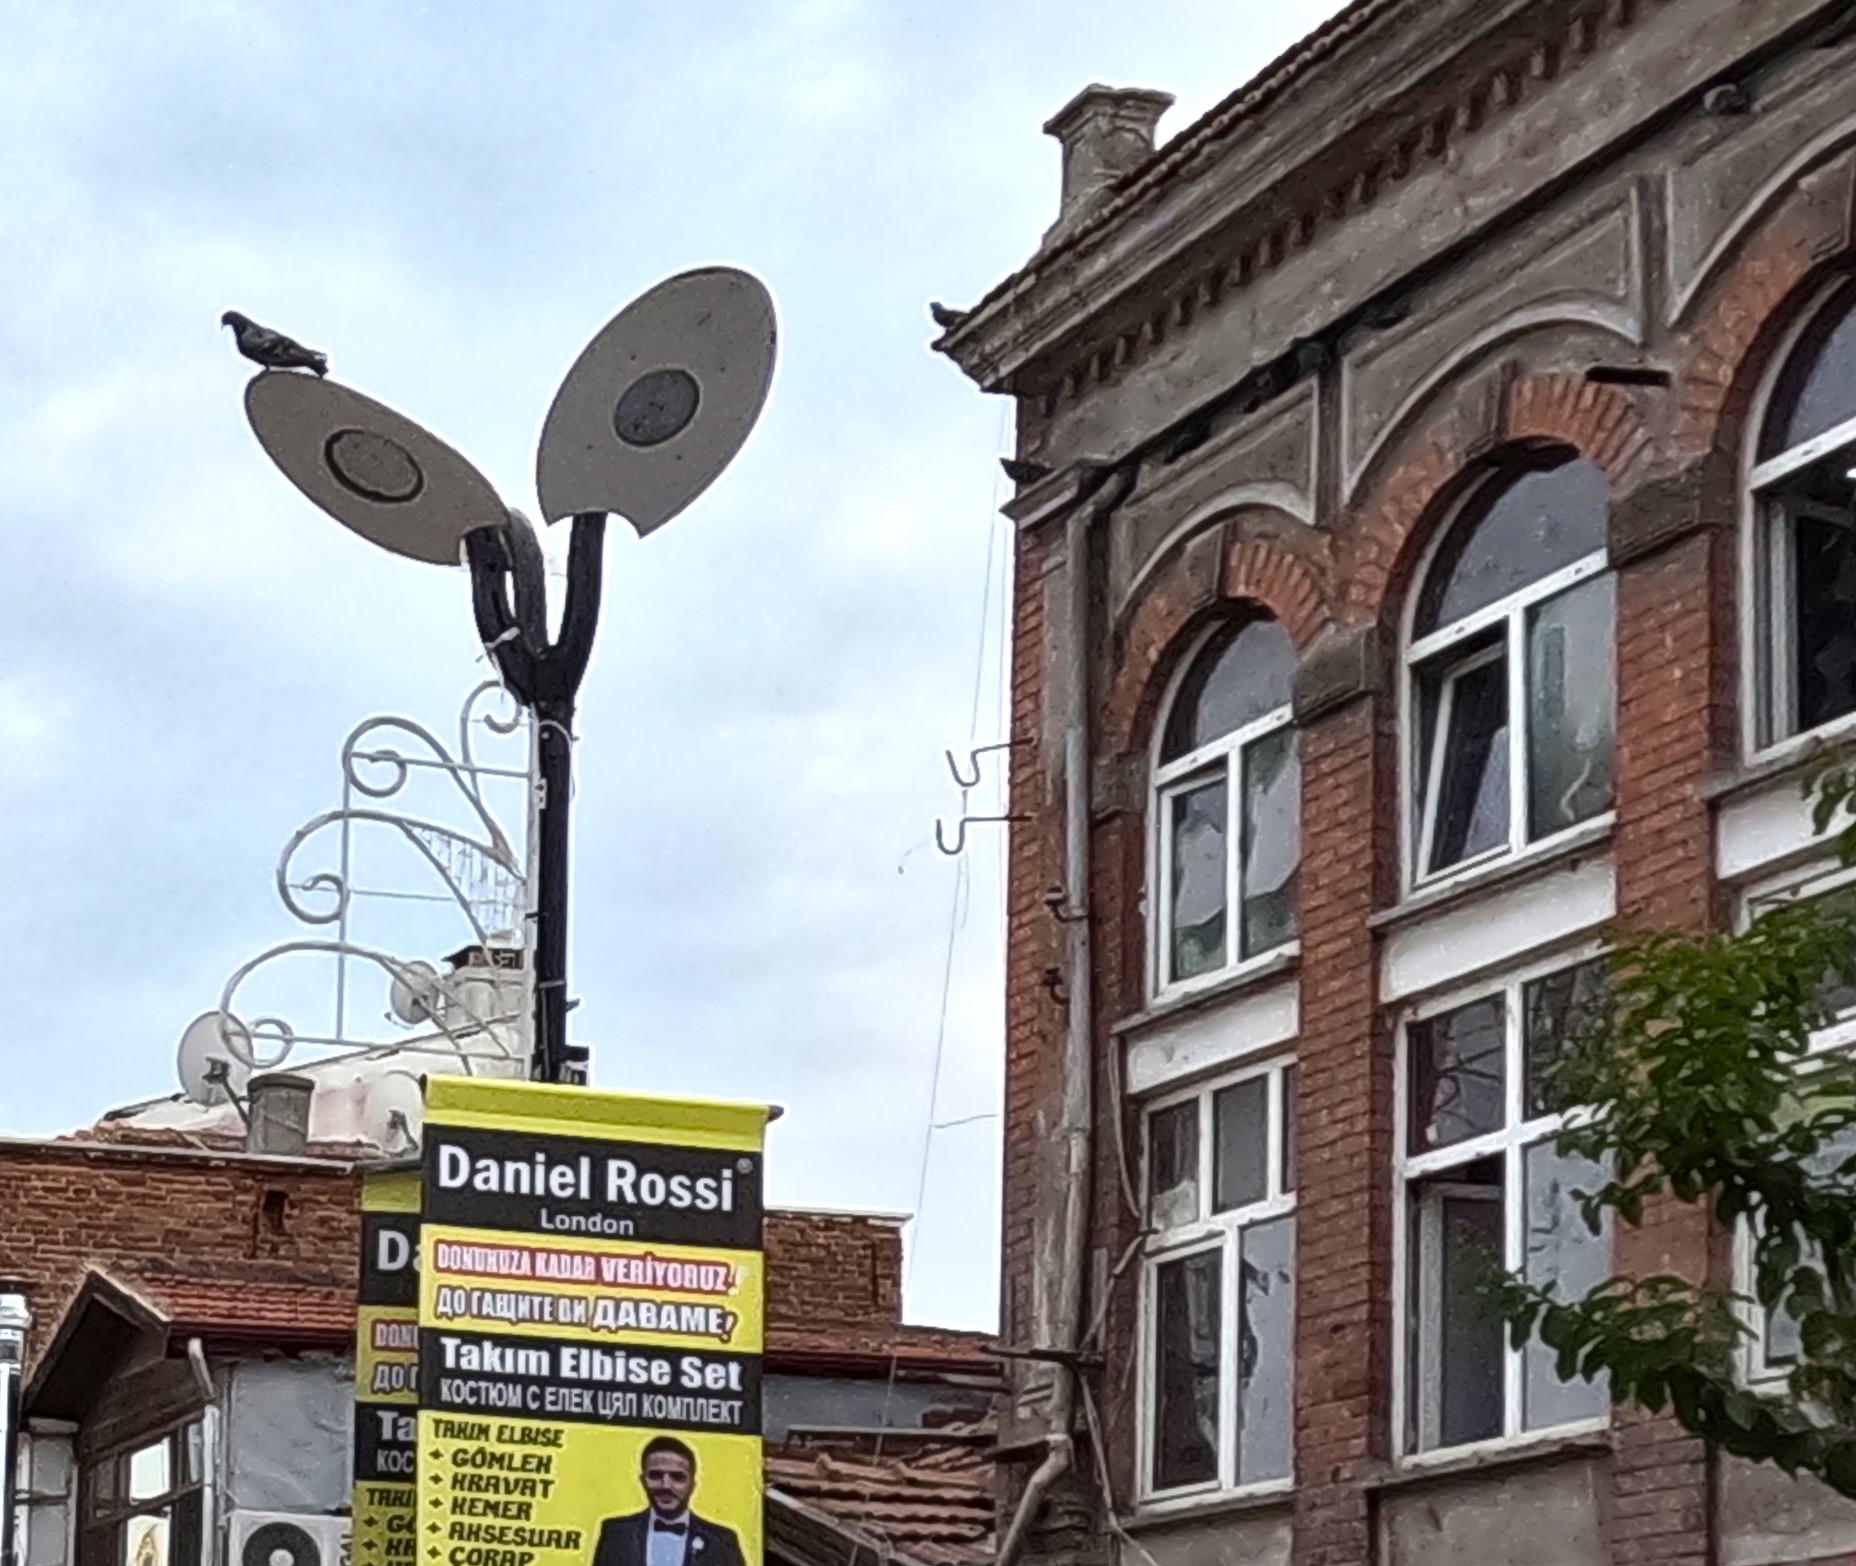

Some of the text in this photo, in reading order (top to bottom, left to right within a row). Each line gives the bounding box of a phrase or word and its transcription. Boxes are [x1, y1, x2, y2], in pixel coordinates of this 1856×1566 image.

[439, 1144, 734, 1211] Daniel Rossi
[540, 1207, 635, 1236] London
[437, 1242, 532, 1277] DONUNUZA
[535, 1250, 596, 1281] KADAR
[436, 1286, 466, 1317] ДО
[471, 1289, 554, 1323] ГАЩИТЕ
[592, 1299, 737, 1340] ДАВАМЕ!
[440, 1336, 743, 1392] Takım Elbise Set
[439, 1377, 523, 1408] КОСТЮМ
[544, 1386, 595, 1413] ЕЛЕК
[597, 1389, 638, 1420] ЦЯЛ
[641, 1392, 744, 1426] КОМПЛЕКТ
[449, 1496, 533, 1522] KEMER
[447, 1521, 583, 1551] AKSESUAR
